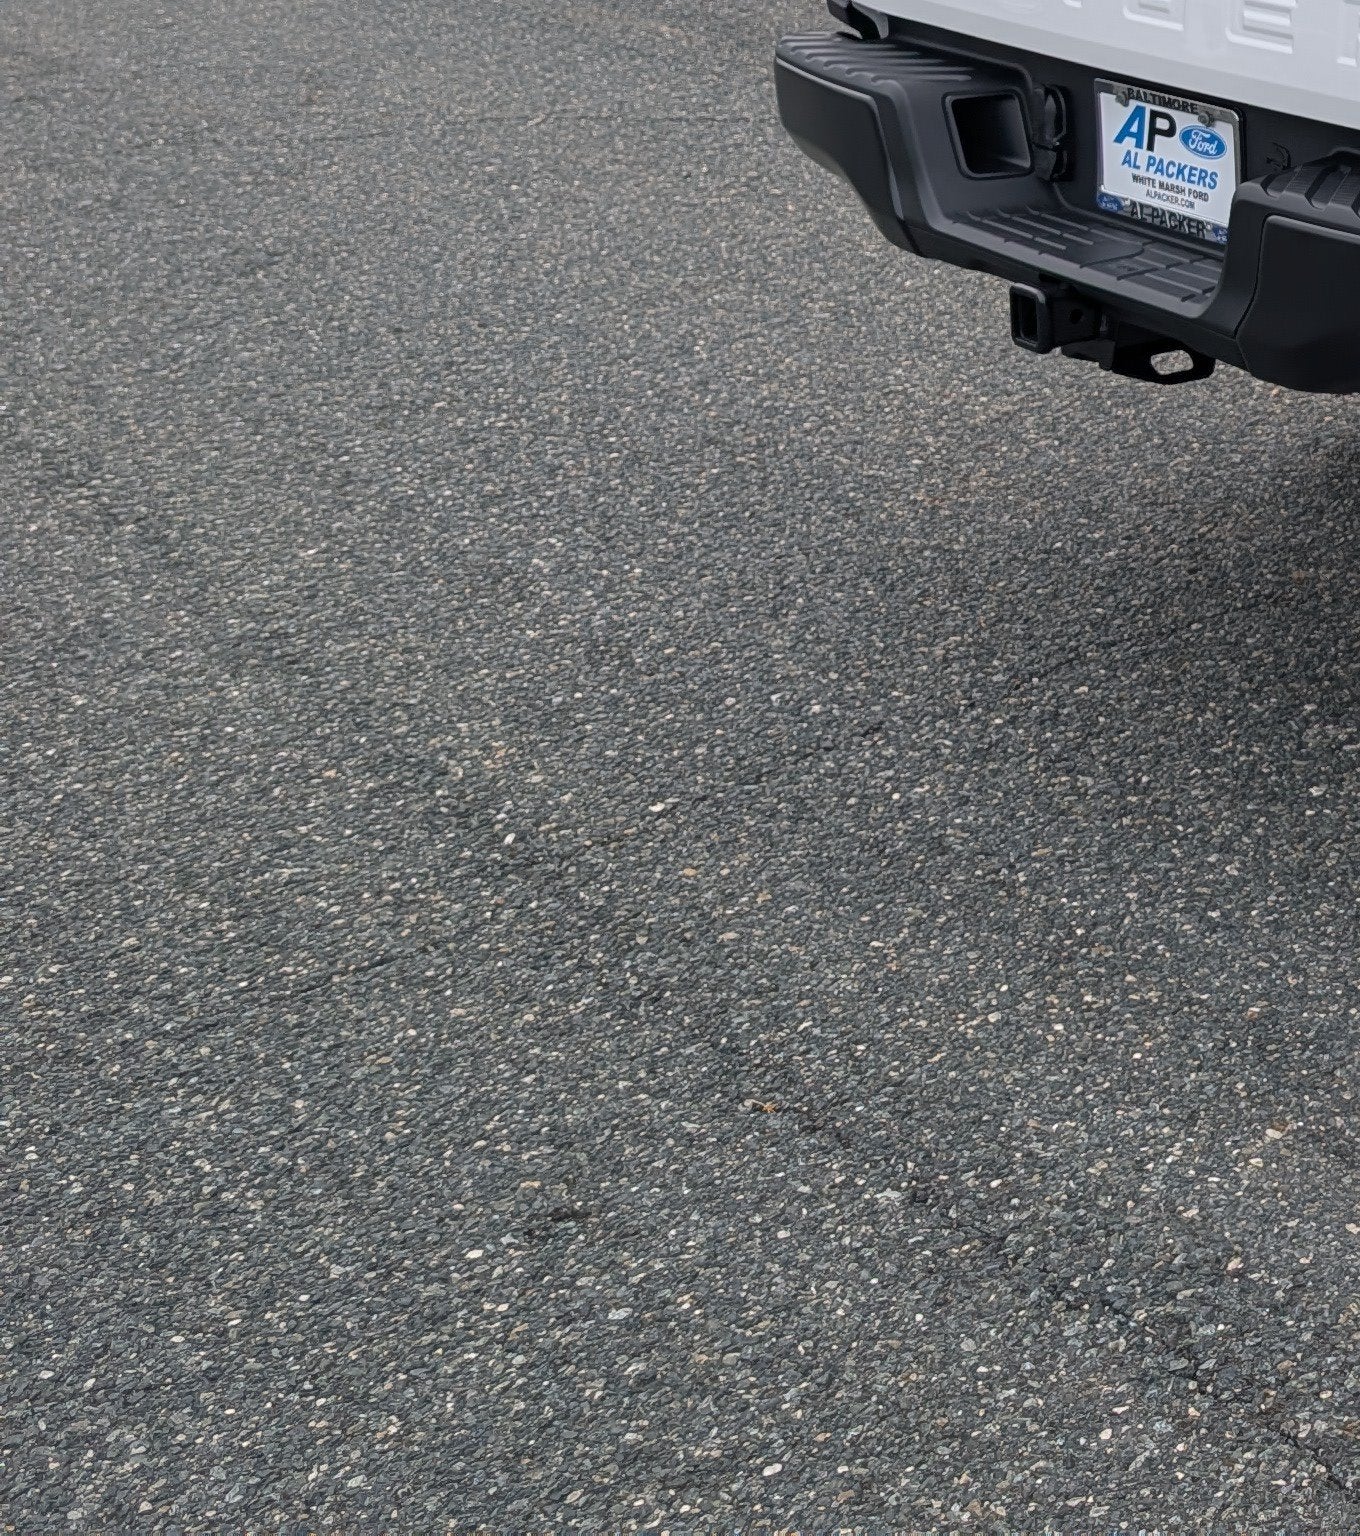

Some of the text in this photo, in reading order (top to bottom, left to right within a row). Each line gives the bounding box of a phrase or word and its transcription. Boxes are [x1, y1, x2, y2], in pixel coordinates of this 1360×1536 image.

[1127, 87, 1199, 113] BALTIMORE
[1113, 104, 1177, 153] AP
[1121, 149, 1219, 190] AL PACKERS
[1131, 172, 1210, 203] WHITE MARSH FORD
[1151, 206, 1207, 239] PACKER
